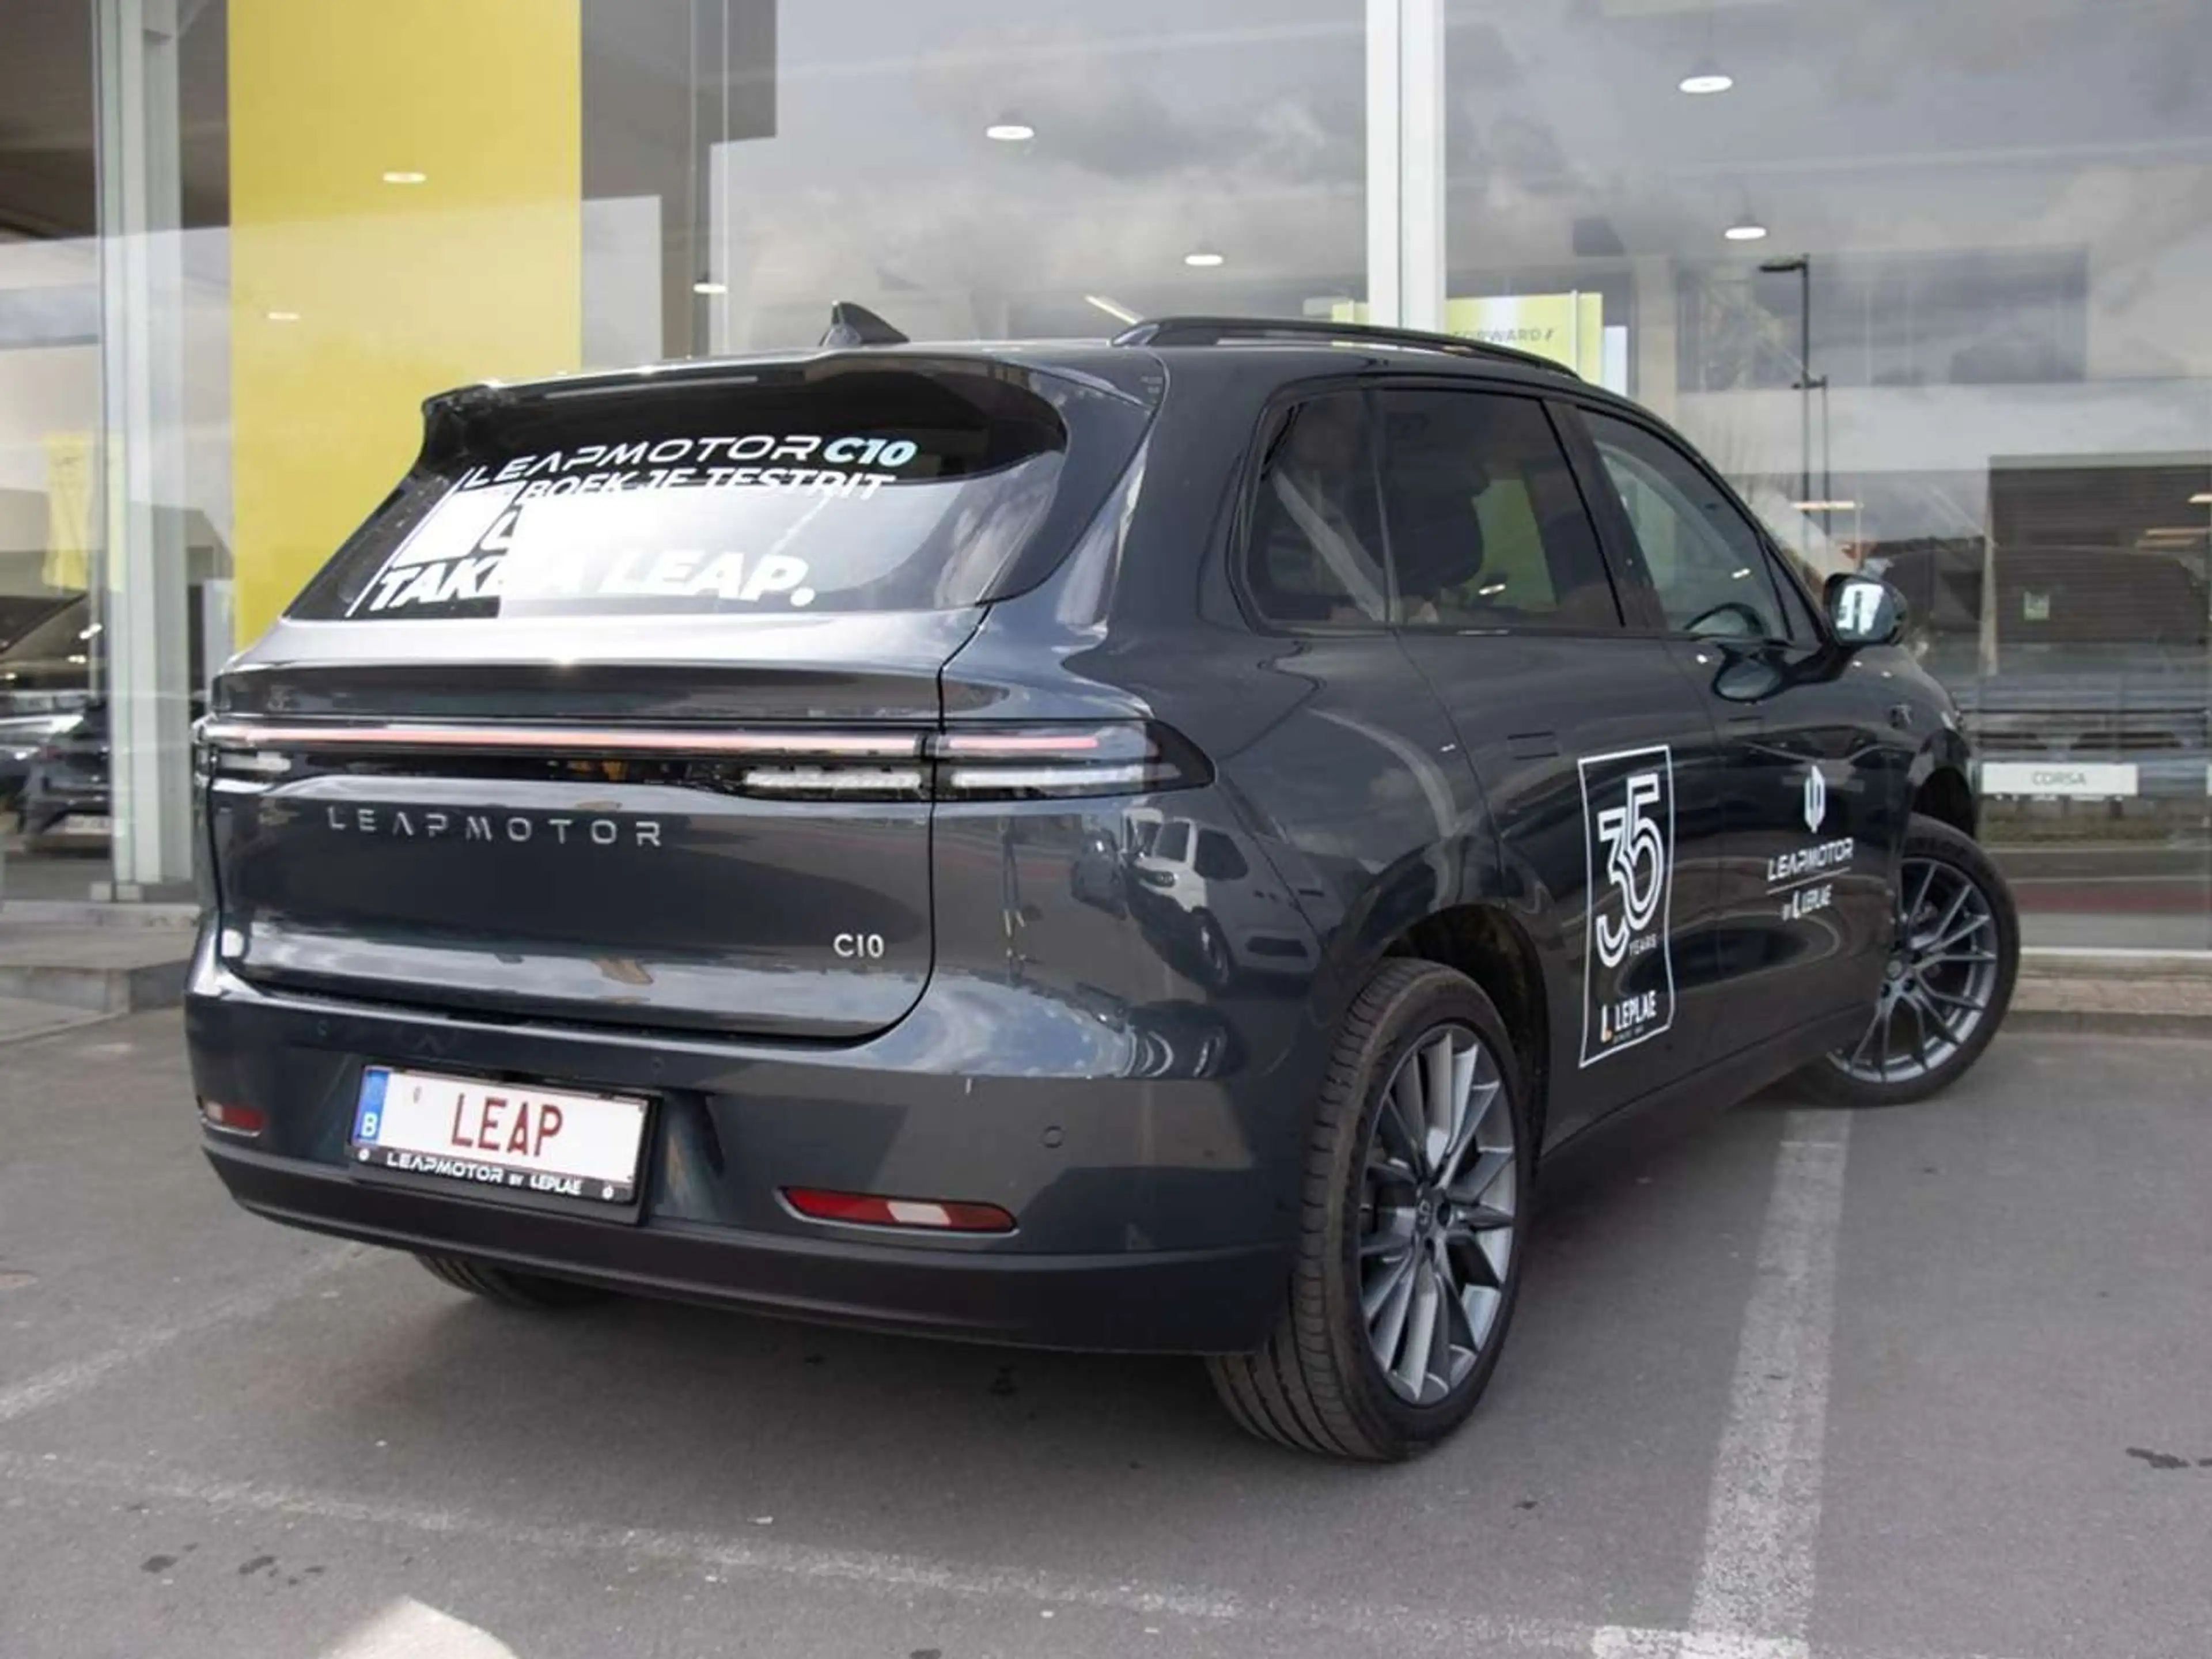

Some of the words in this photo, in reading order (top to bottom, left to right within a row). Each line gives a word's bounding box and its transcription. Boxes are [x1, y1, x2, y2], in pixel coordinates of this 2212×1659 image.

[463, 435, 822, 489] LEAPMOTOR
[824, 437, 918, 467] C10
[515, 472, 639, 505] BOEK
[634, 468, 698, 491] JE
[706, 467, 896, 500] TESTRIT
[369, 556, 536, 611] TAK
[598, 548, 815, 607] LEAP.
[2032, 771, 2087, 786] CORSA
[327, 806, 661, 847] LEAPMOTOR
[1767, 837, 1854, 882] LEAPMOTOR
[833, 933, 884, 959] C10
[1615, 990, 1657, 1032] LEPLAE
[362, 1112, 378, 1138] B
[450, 1092, 564, 1157] LEAP
[386, 1152, 505, 1184] LEAPMOTOR
[529, 1173, 582, 1196] LEPLAE
